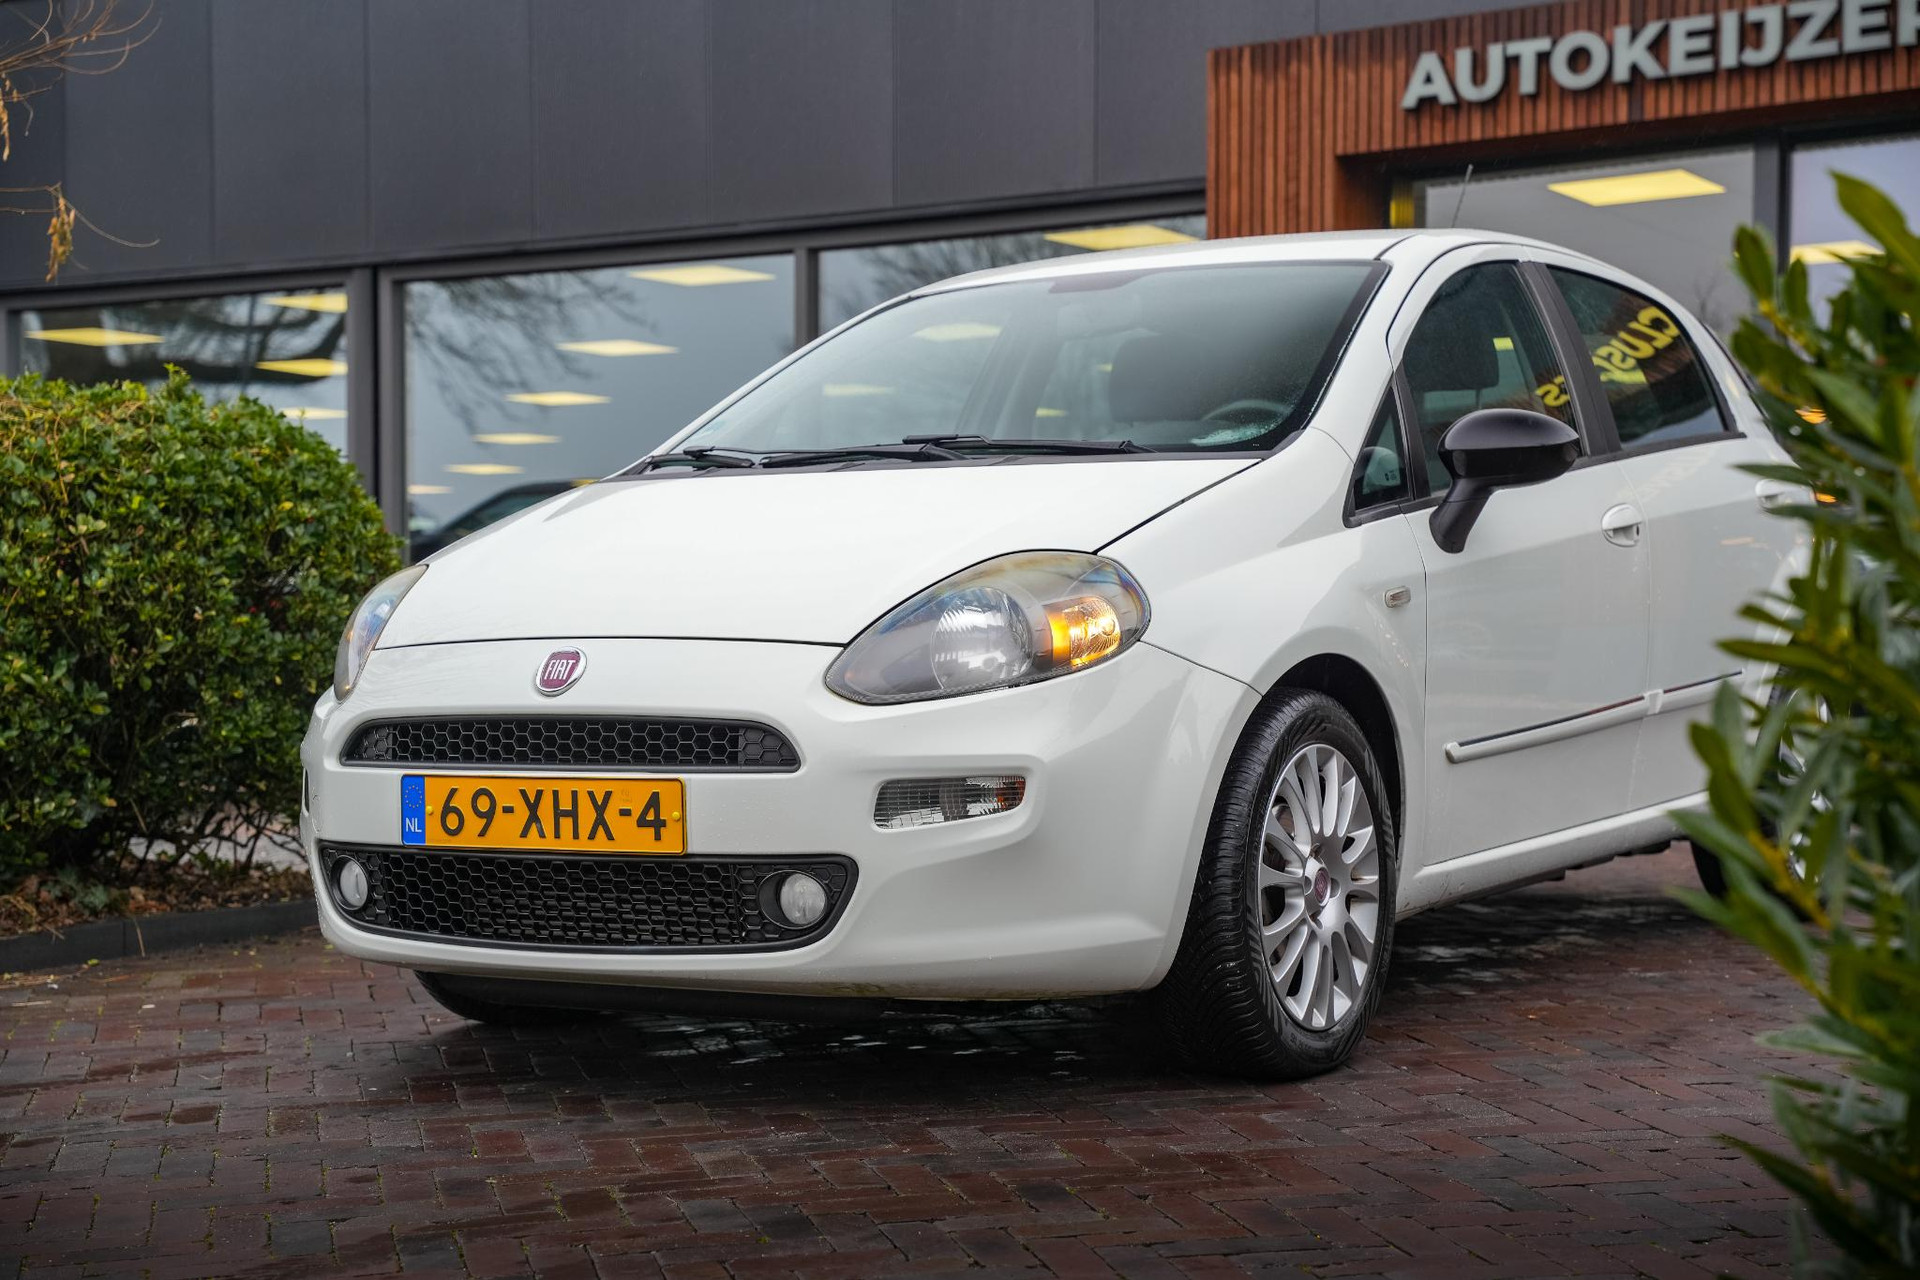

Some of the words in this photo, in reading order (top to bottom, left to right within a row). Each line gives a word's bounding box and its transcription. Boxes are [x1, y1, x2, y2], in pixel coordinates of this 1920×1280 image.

[543, 659, 577, 680] FIAT
[440, 787, 667, 841] 69-XHX-4
[405, 817, 422, 833] NL
